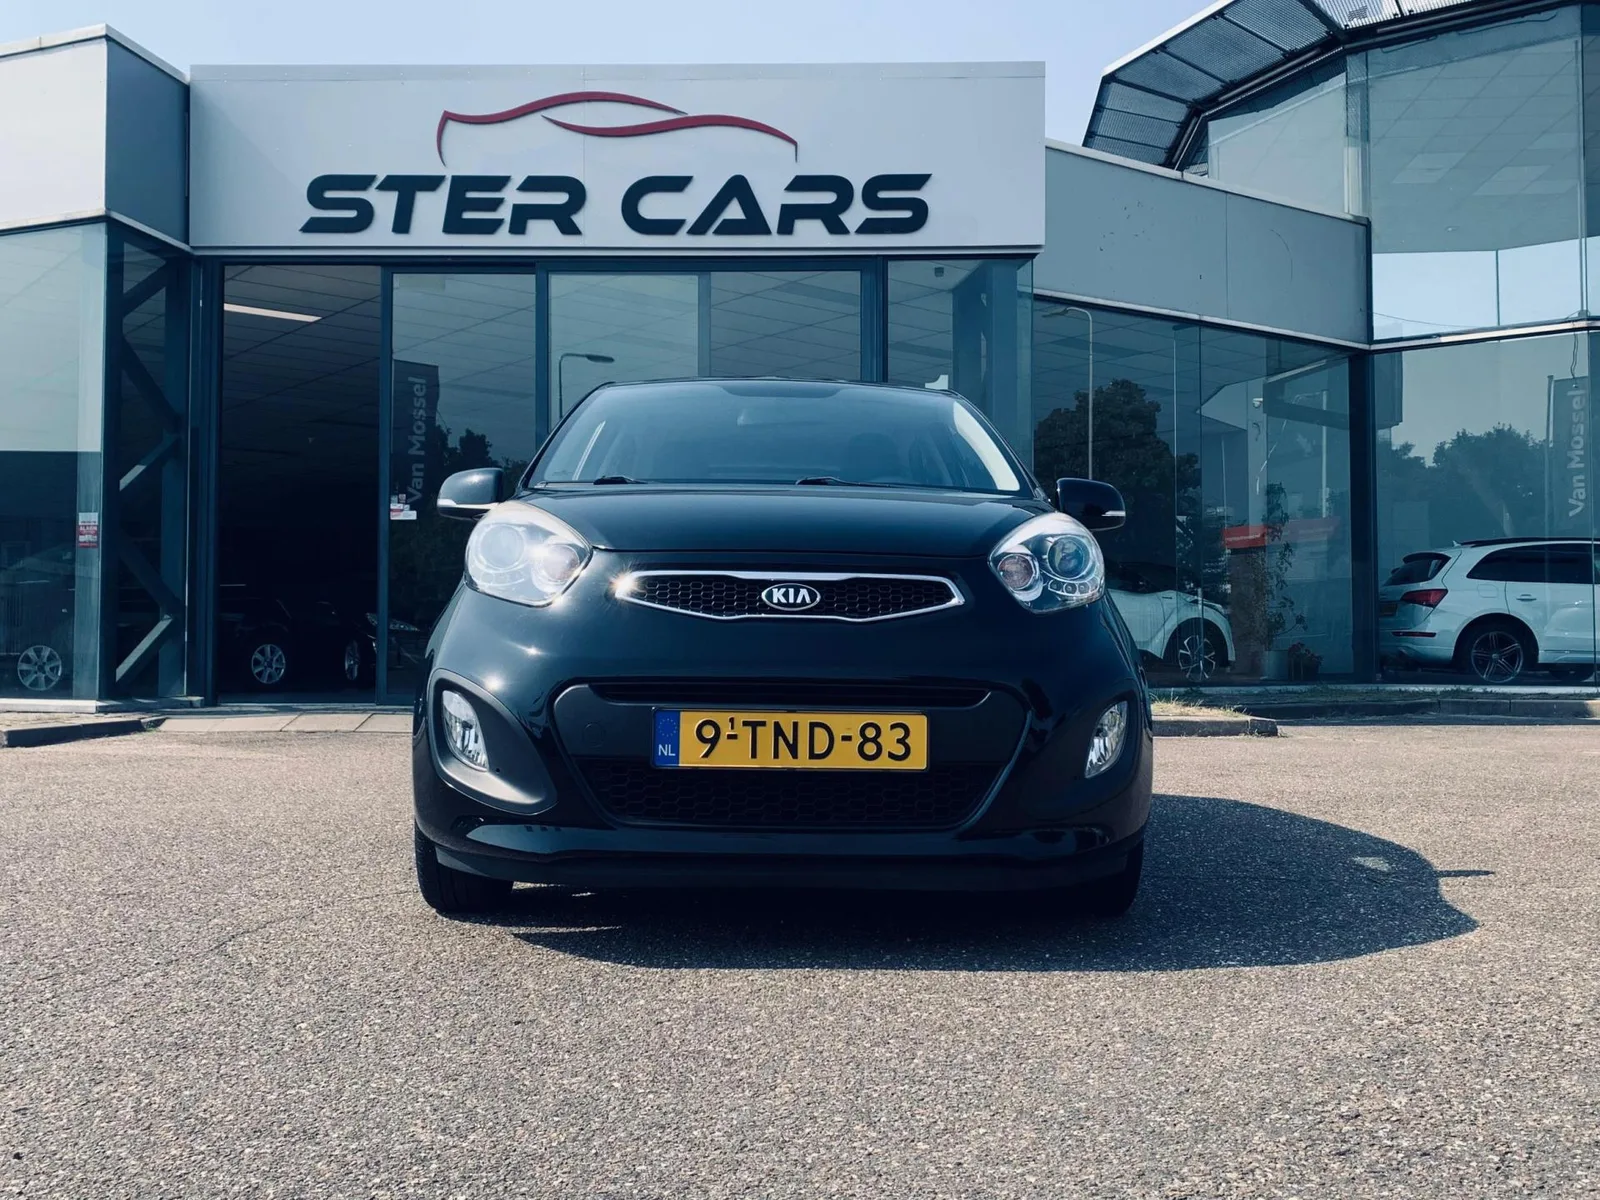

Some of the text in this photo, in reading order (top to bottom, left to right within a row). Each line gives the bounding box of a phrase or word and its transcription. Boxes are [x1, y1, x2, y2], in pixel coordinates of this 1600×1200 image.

[299, 173, 933, 235] STER CARS
[407, 376, 427, 503] Van Mossel
[1567, 389, 1586, 517] Van Mossel
[772, 588, 811, 603] KIA
[658, 744, 676, 756] NL
